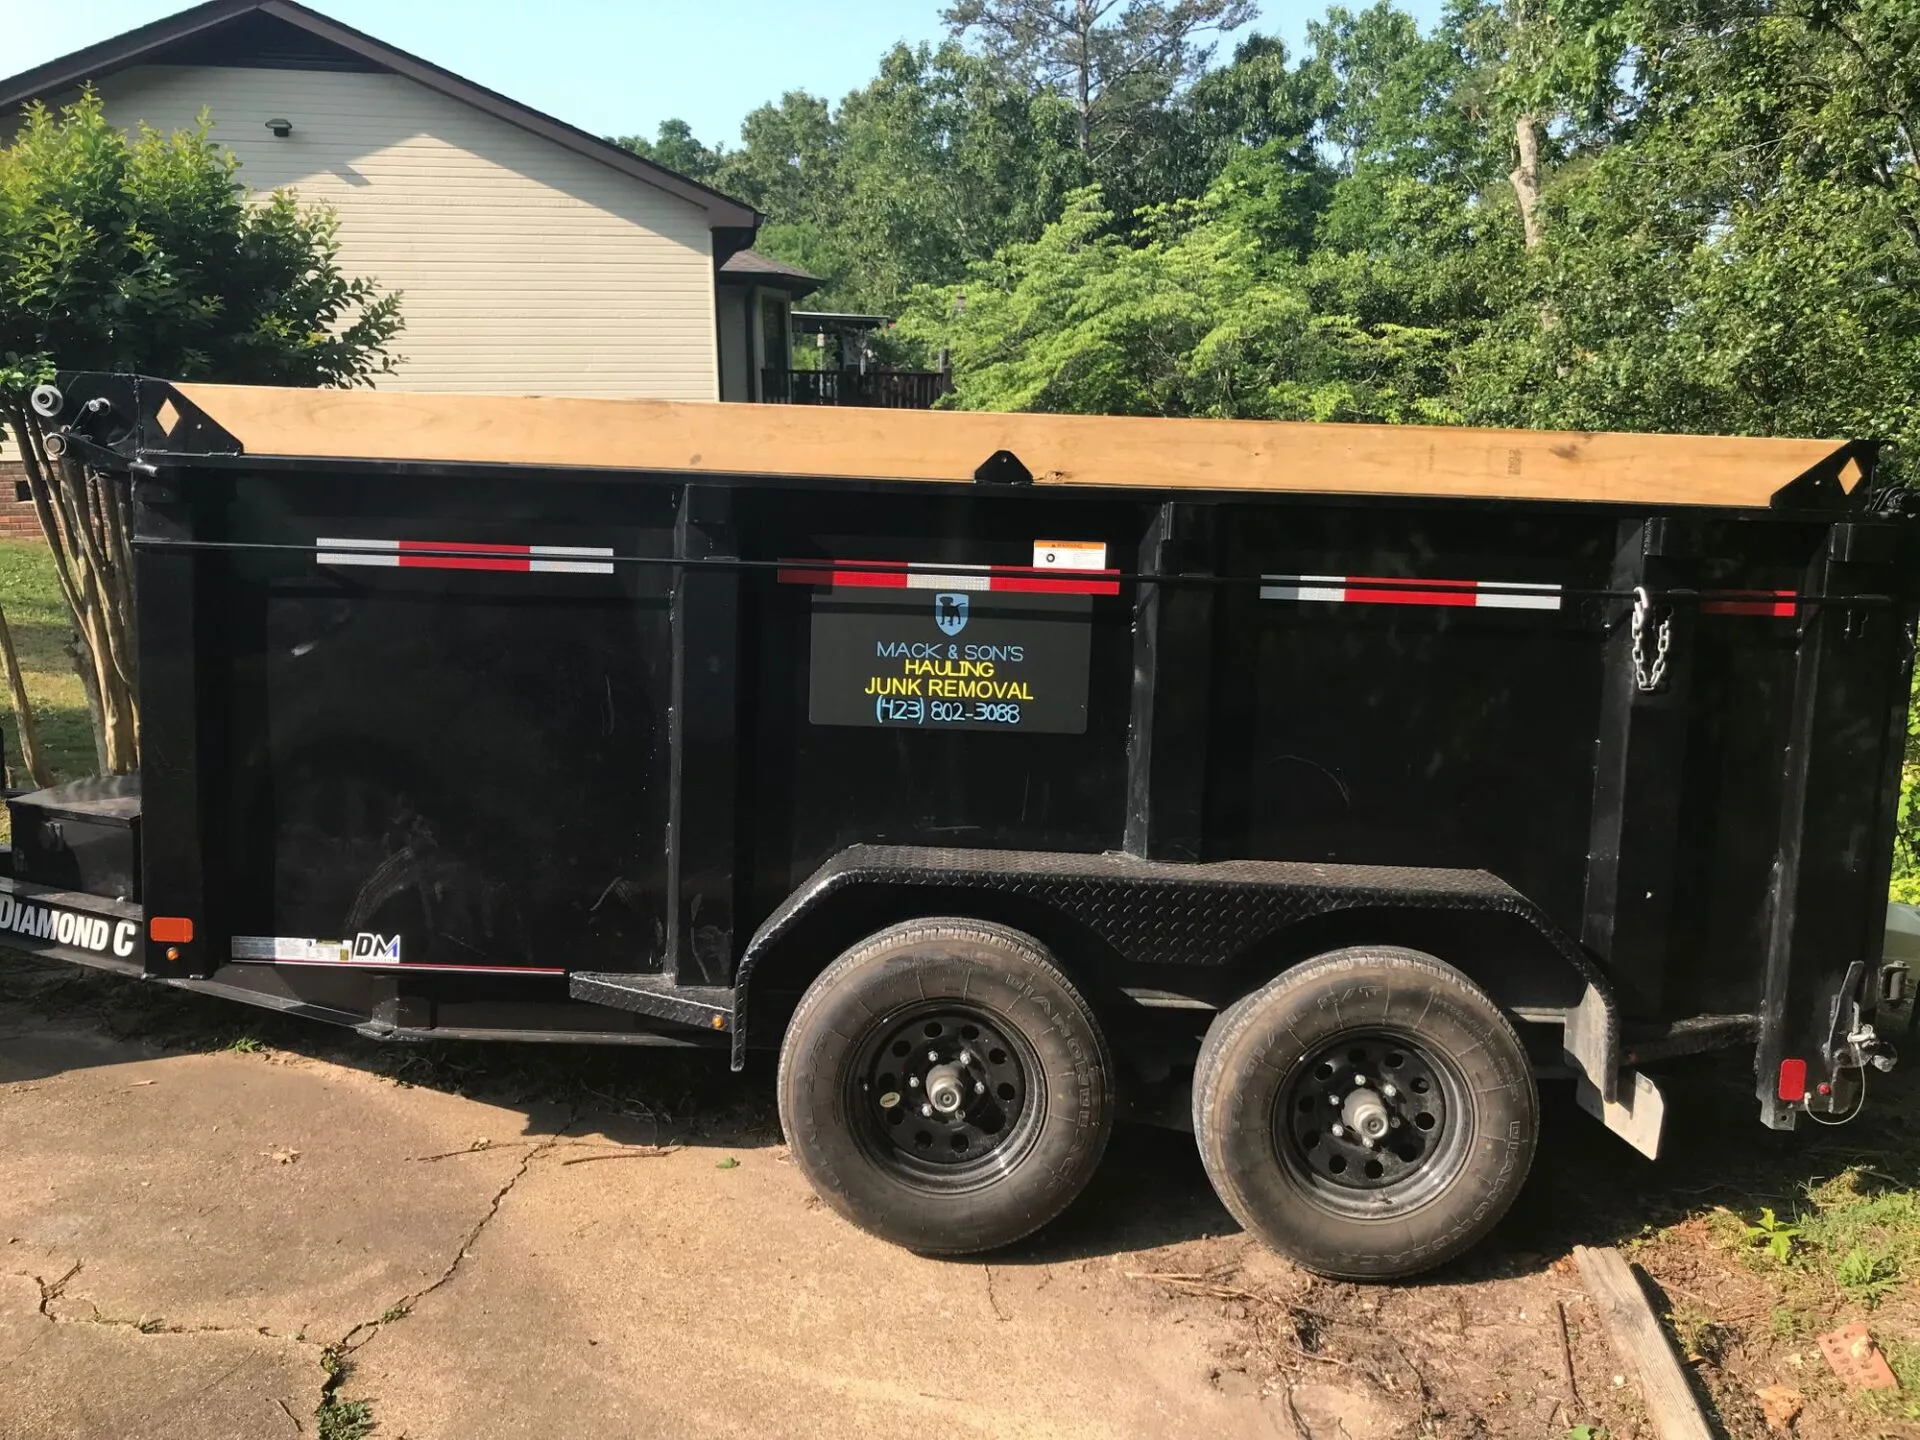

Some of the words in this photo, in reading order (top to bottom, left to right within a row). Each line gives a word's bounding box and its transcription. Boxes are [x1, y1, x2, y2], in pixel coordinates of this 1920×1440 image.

[877, 641, 942, 659] MACK
[948, 644, 958, 659] &
[964, 645, 1024, 662] SON'S
[905, 659, 995, 677] HAULING
[865, 677, 922, 696] JUNK
[928, 680, 1034, 700] REMOVAL
[876, 695, 924, 723] (423)
[931, 701, 1020, 723] 802-3088
[0, 893, 109, 951] DIAMOND
[113, 919, 136, 957] C
